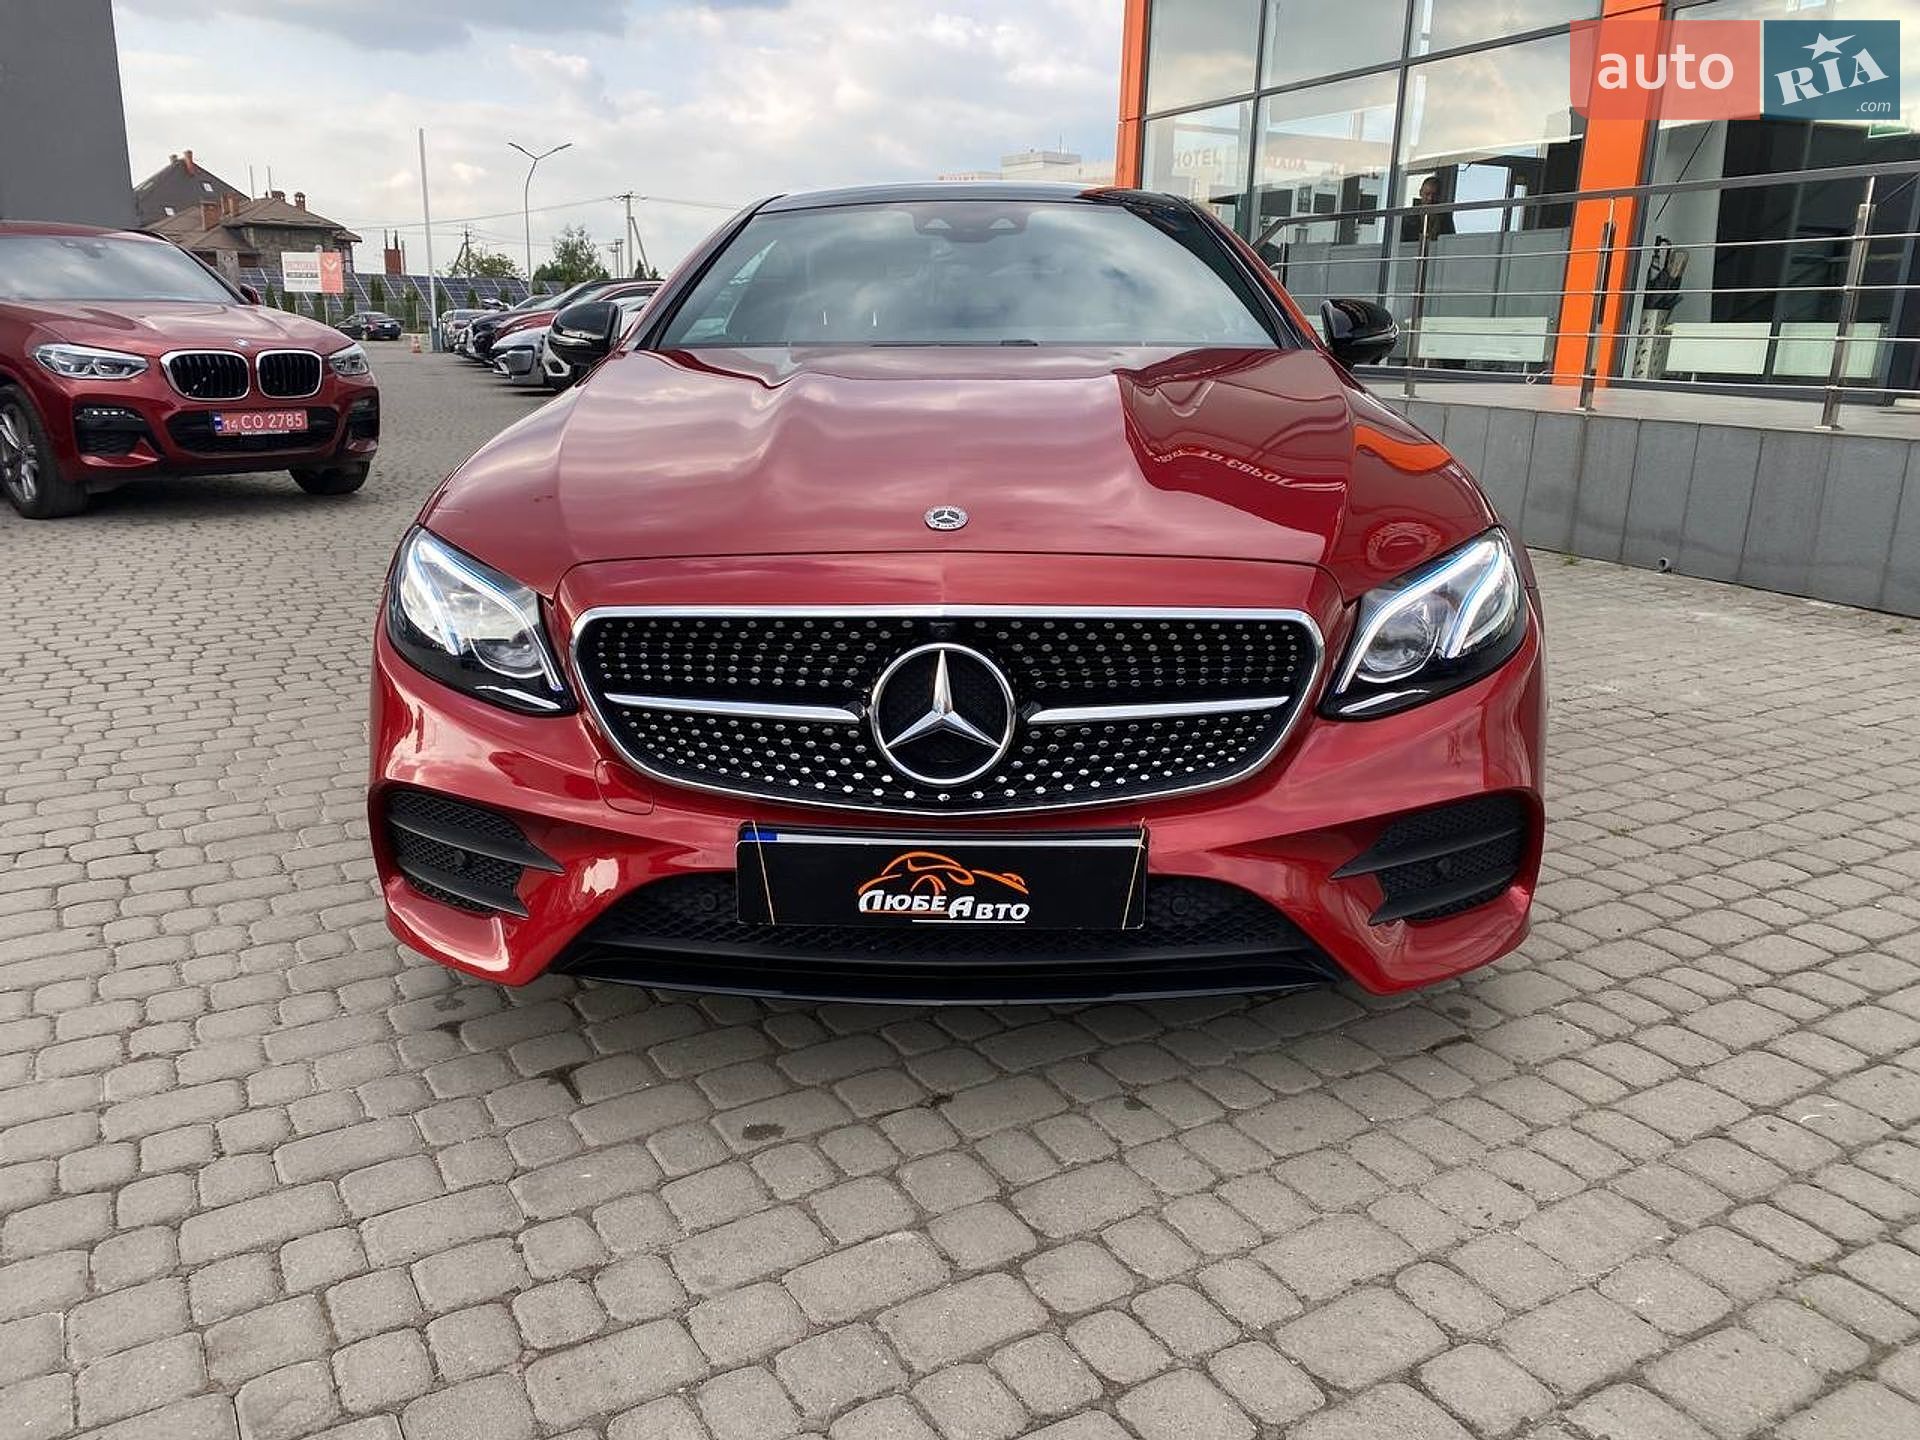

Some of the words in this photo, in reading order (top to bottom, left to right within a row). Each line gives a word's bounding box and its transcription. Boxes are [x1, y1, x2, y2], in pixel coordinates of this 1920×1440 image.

[224, 420, 238, 430] 14
[241, 415, 264, 429] CO
[267, 413, 303, 429] 2785
